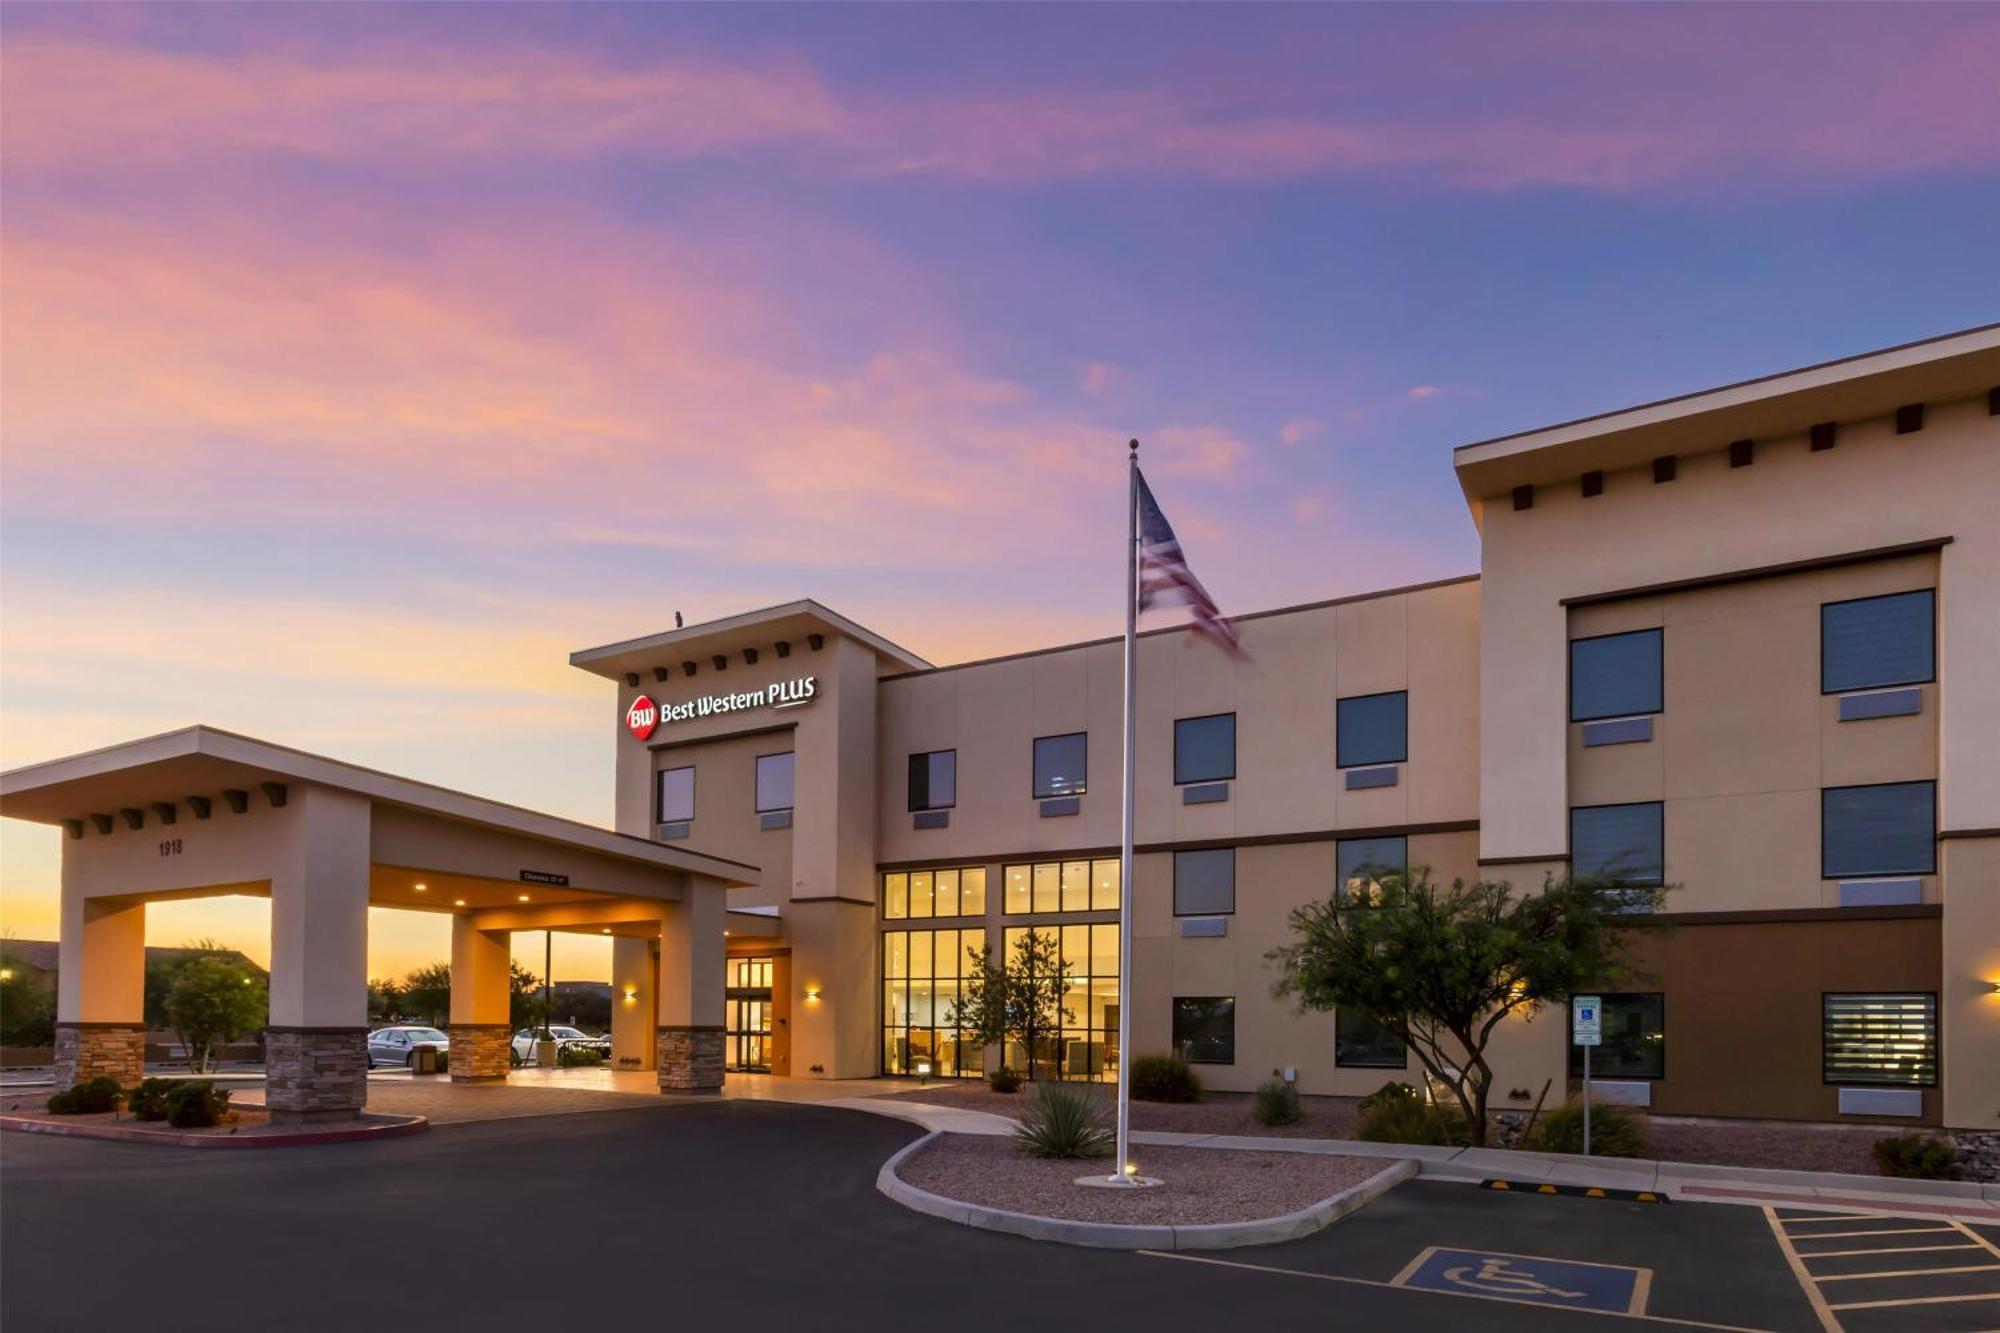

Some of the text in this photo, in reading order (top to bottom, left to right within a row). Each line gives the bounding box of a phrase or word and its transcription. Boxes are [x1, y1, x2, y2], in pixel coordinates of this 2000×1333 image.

[660, 676, 815, 723] Best Western PLUS
[630, 709, 654, 728] BW
[159, 838, 183, 857] 1918
